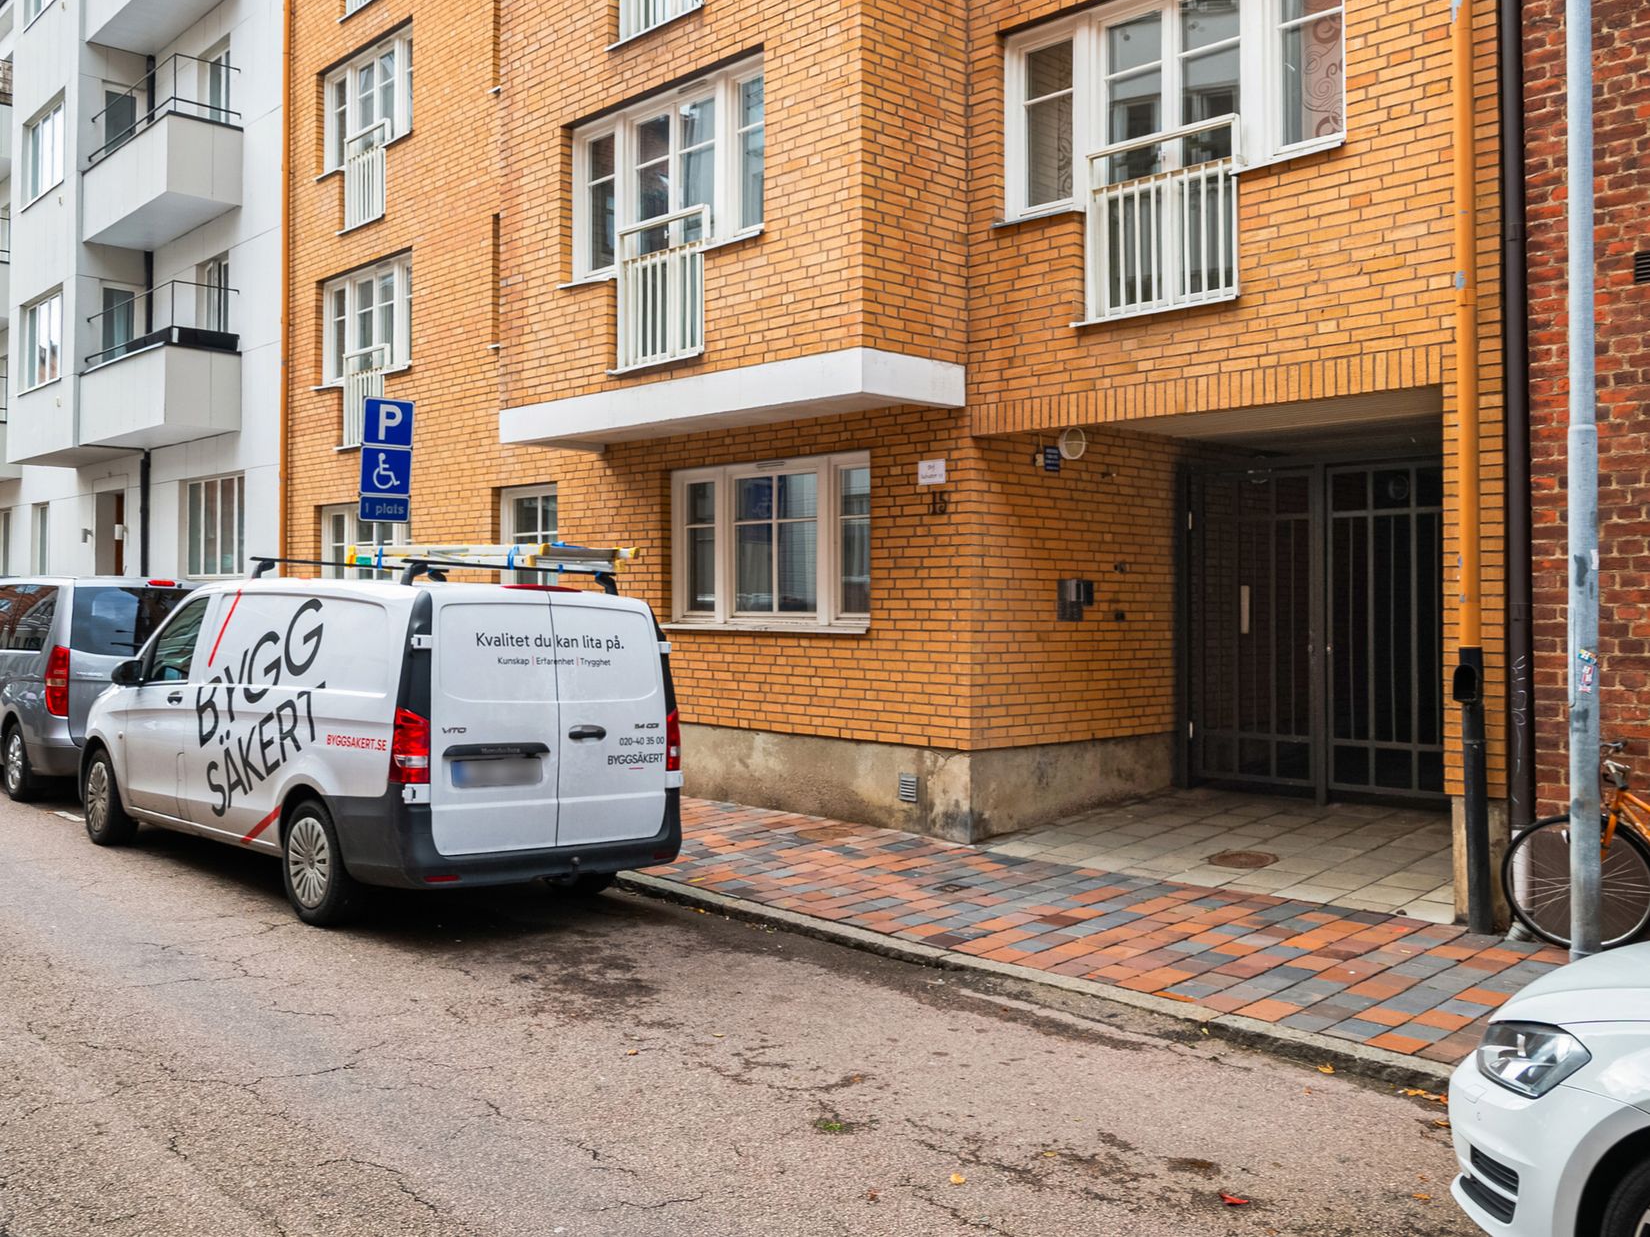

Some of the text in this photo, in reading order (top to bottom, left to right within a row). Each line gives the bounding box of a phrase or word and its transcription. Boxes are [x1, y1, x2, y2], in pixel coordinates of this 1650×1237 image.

[377, 403, 403, 441] P
[364, 502, 405, 516] 1 plats
[931, 490, 948, 515] 15
[475, 632, 625, 652] Kvalitet du kan lita på.
[497, 657, 611, 667] Kunskap Erfarenhet Trygghet
[195, 598, 324, 748] BYGG
[441, 726, 467, 734] VITO
[206, 680, 326, 818] SÄKERT
[326, 734, 387, 751] BYGGSAKERT.SE
[619, 736, 665, 746] 020-40 35 00
